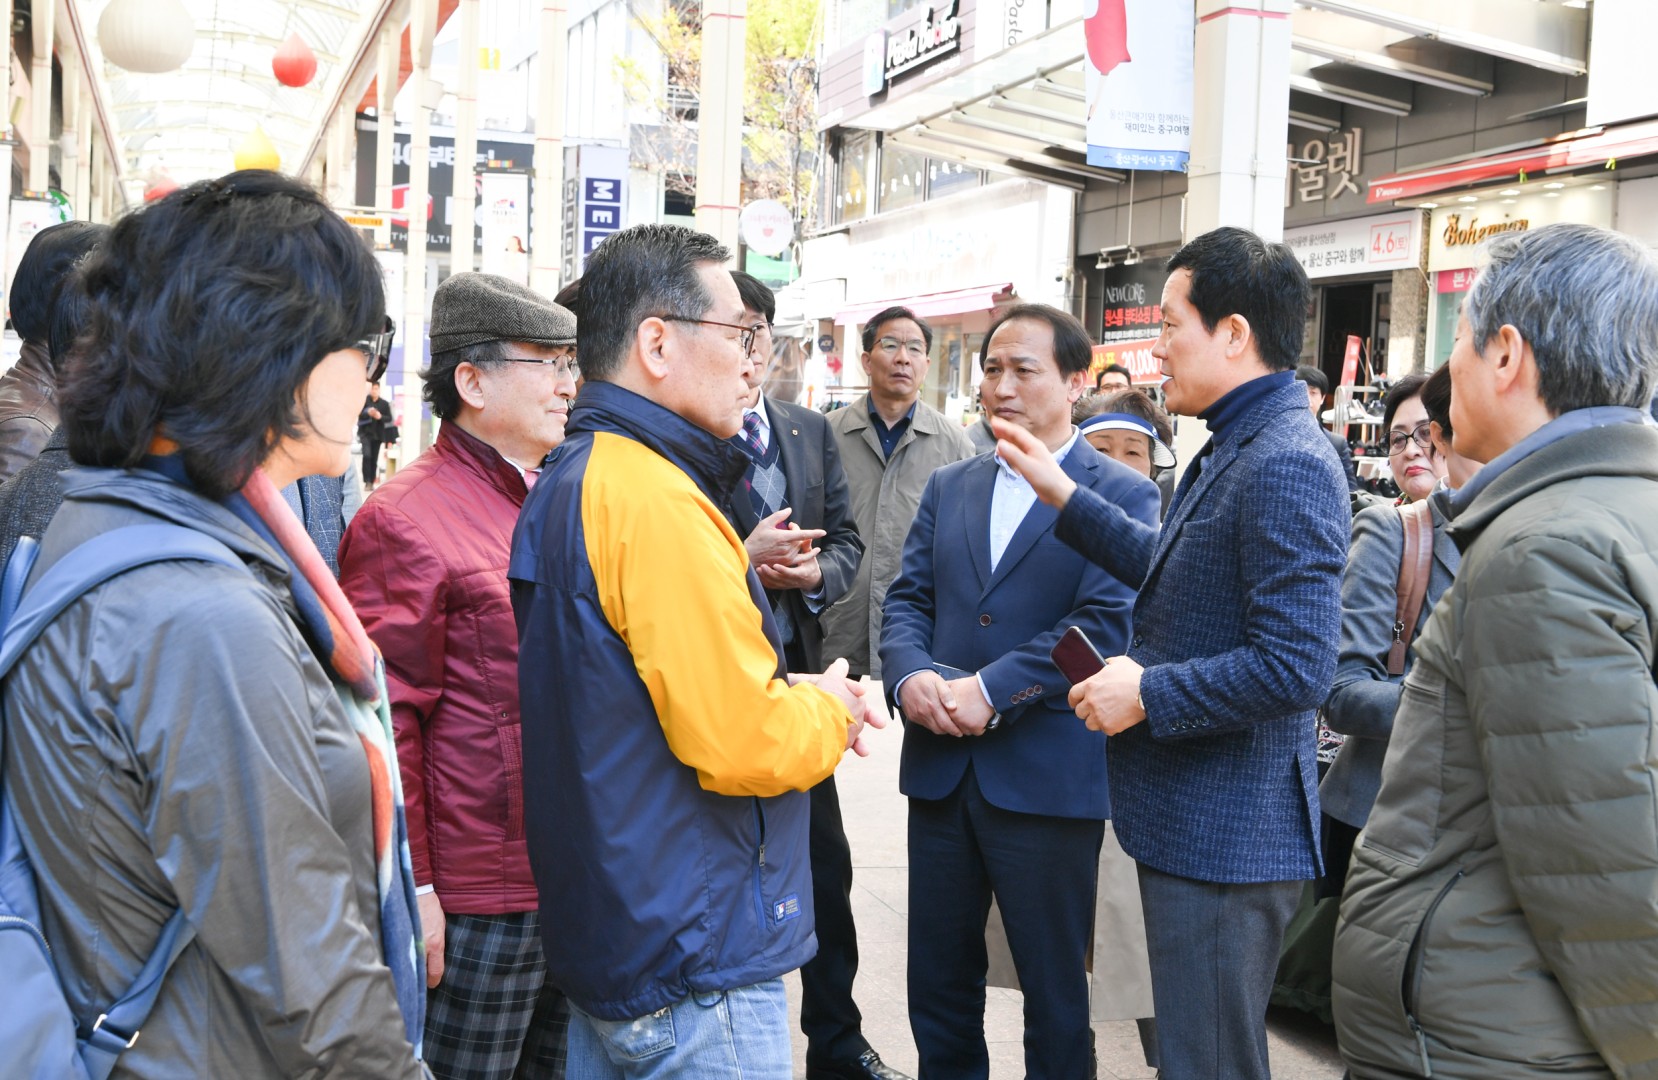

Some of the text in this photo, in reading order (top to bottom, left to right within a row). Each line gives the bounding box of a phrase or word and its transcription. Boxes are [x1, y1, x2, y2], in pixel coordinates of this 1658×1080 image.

[886, 29, 918, 69] Pasta
[1158, 112, 1190, 125] 함께하는
[1124, 122, 1190, 136] 재미있는 중구여행
[1115, 152, 1175, 166] 울산광역시 중구
[1309, 247, 1365, 267] 울산 중구와 함께
[1104, 308, 1124, 327] 원스톱
[1124, 305, 1151, 325] 뷰티쇼핑
